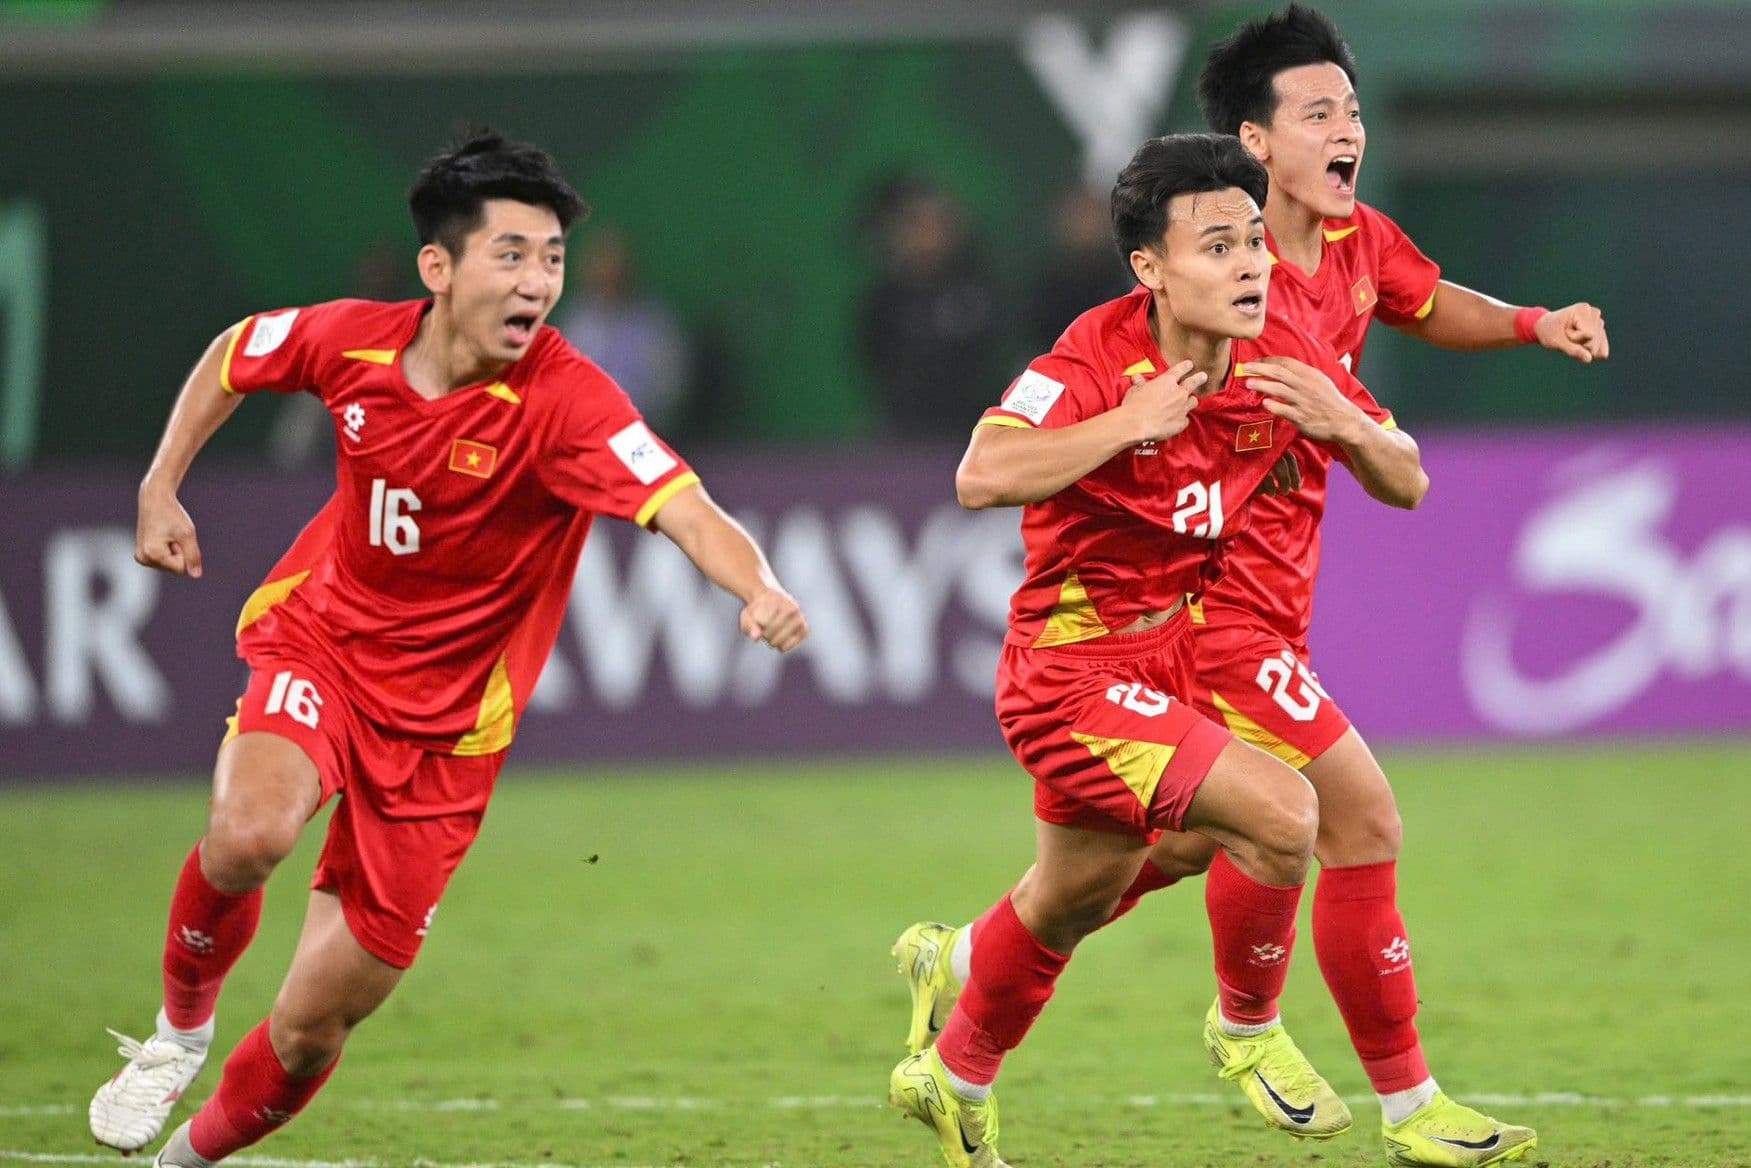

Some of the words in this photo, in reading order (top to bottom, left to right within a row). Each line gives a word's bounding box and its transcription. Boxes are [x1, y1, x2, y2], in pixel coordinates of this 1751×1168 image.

[369, 478, 422, 556] 16
[1171, 479, 1224, 539] 21
[264, 670, 324, 731] 16
